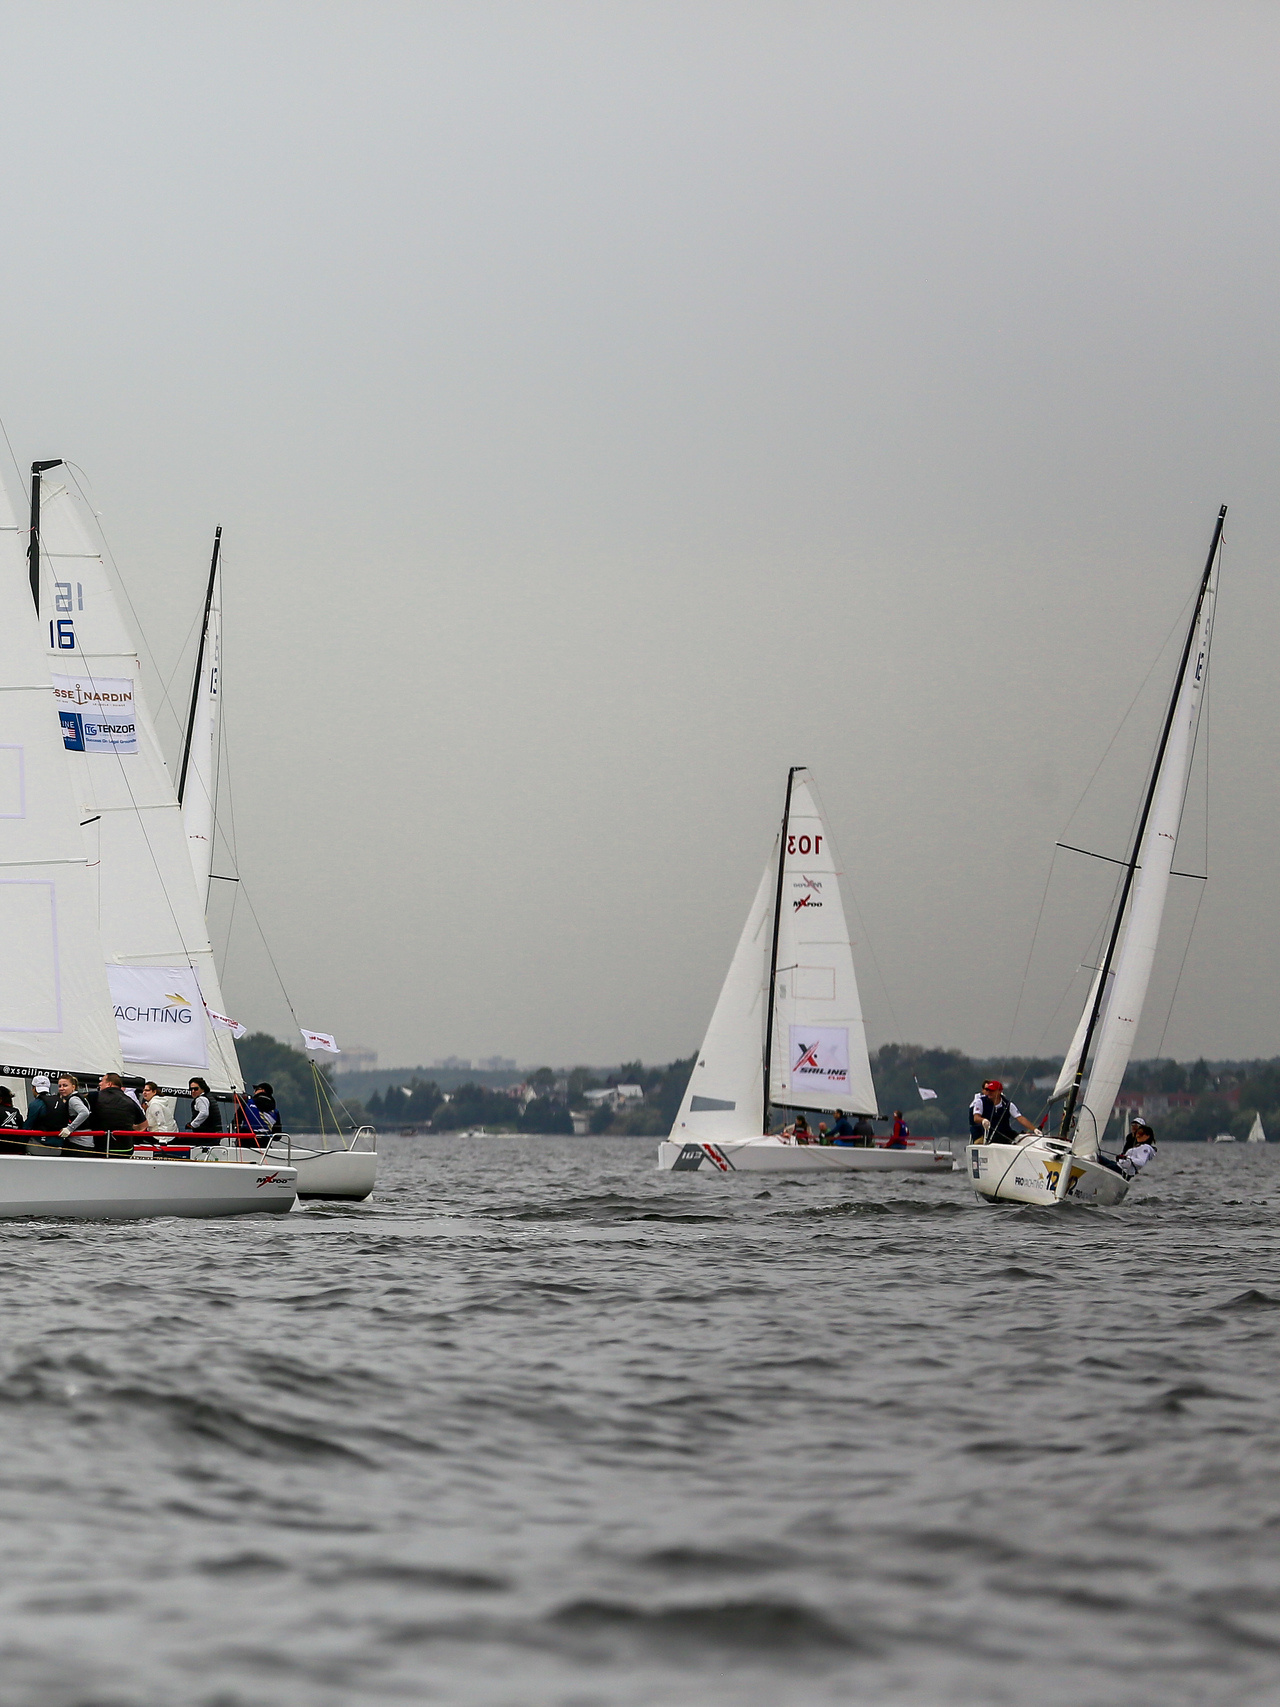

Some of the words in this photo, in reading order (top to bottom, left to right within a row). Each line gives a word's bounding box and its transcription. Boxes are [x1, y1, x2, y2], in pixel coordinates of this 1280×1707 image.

[48, 619, 75, 649] 16
[83, 691, 132, 702] NARDIN
[97, 723, 136, 734] TENZOR
[113, 1005, 192, 1024] ACHTING
[1046, 1170, 1060, 1191] 12
